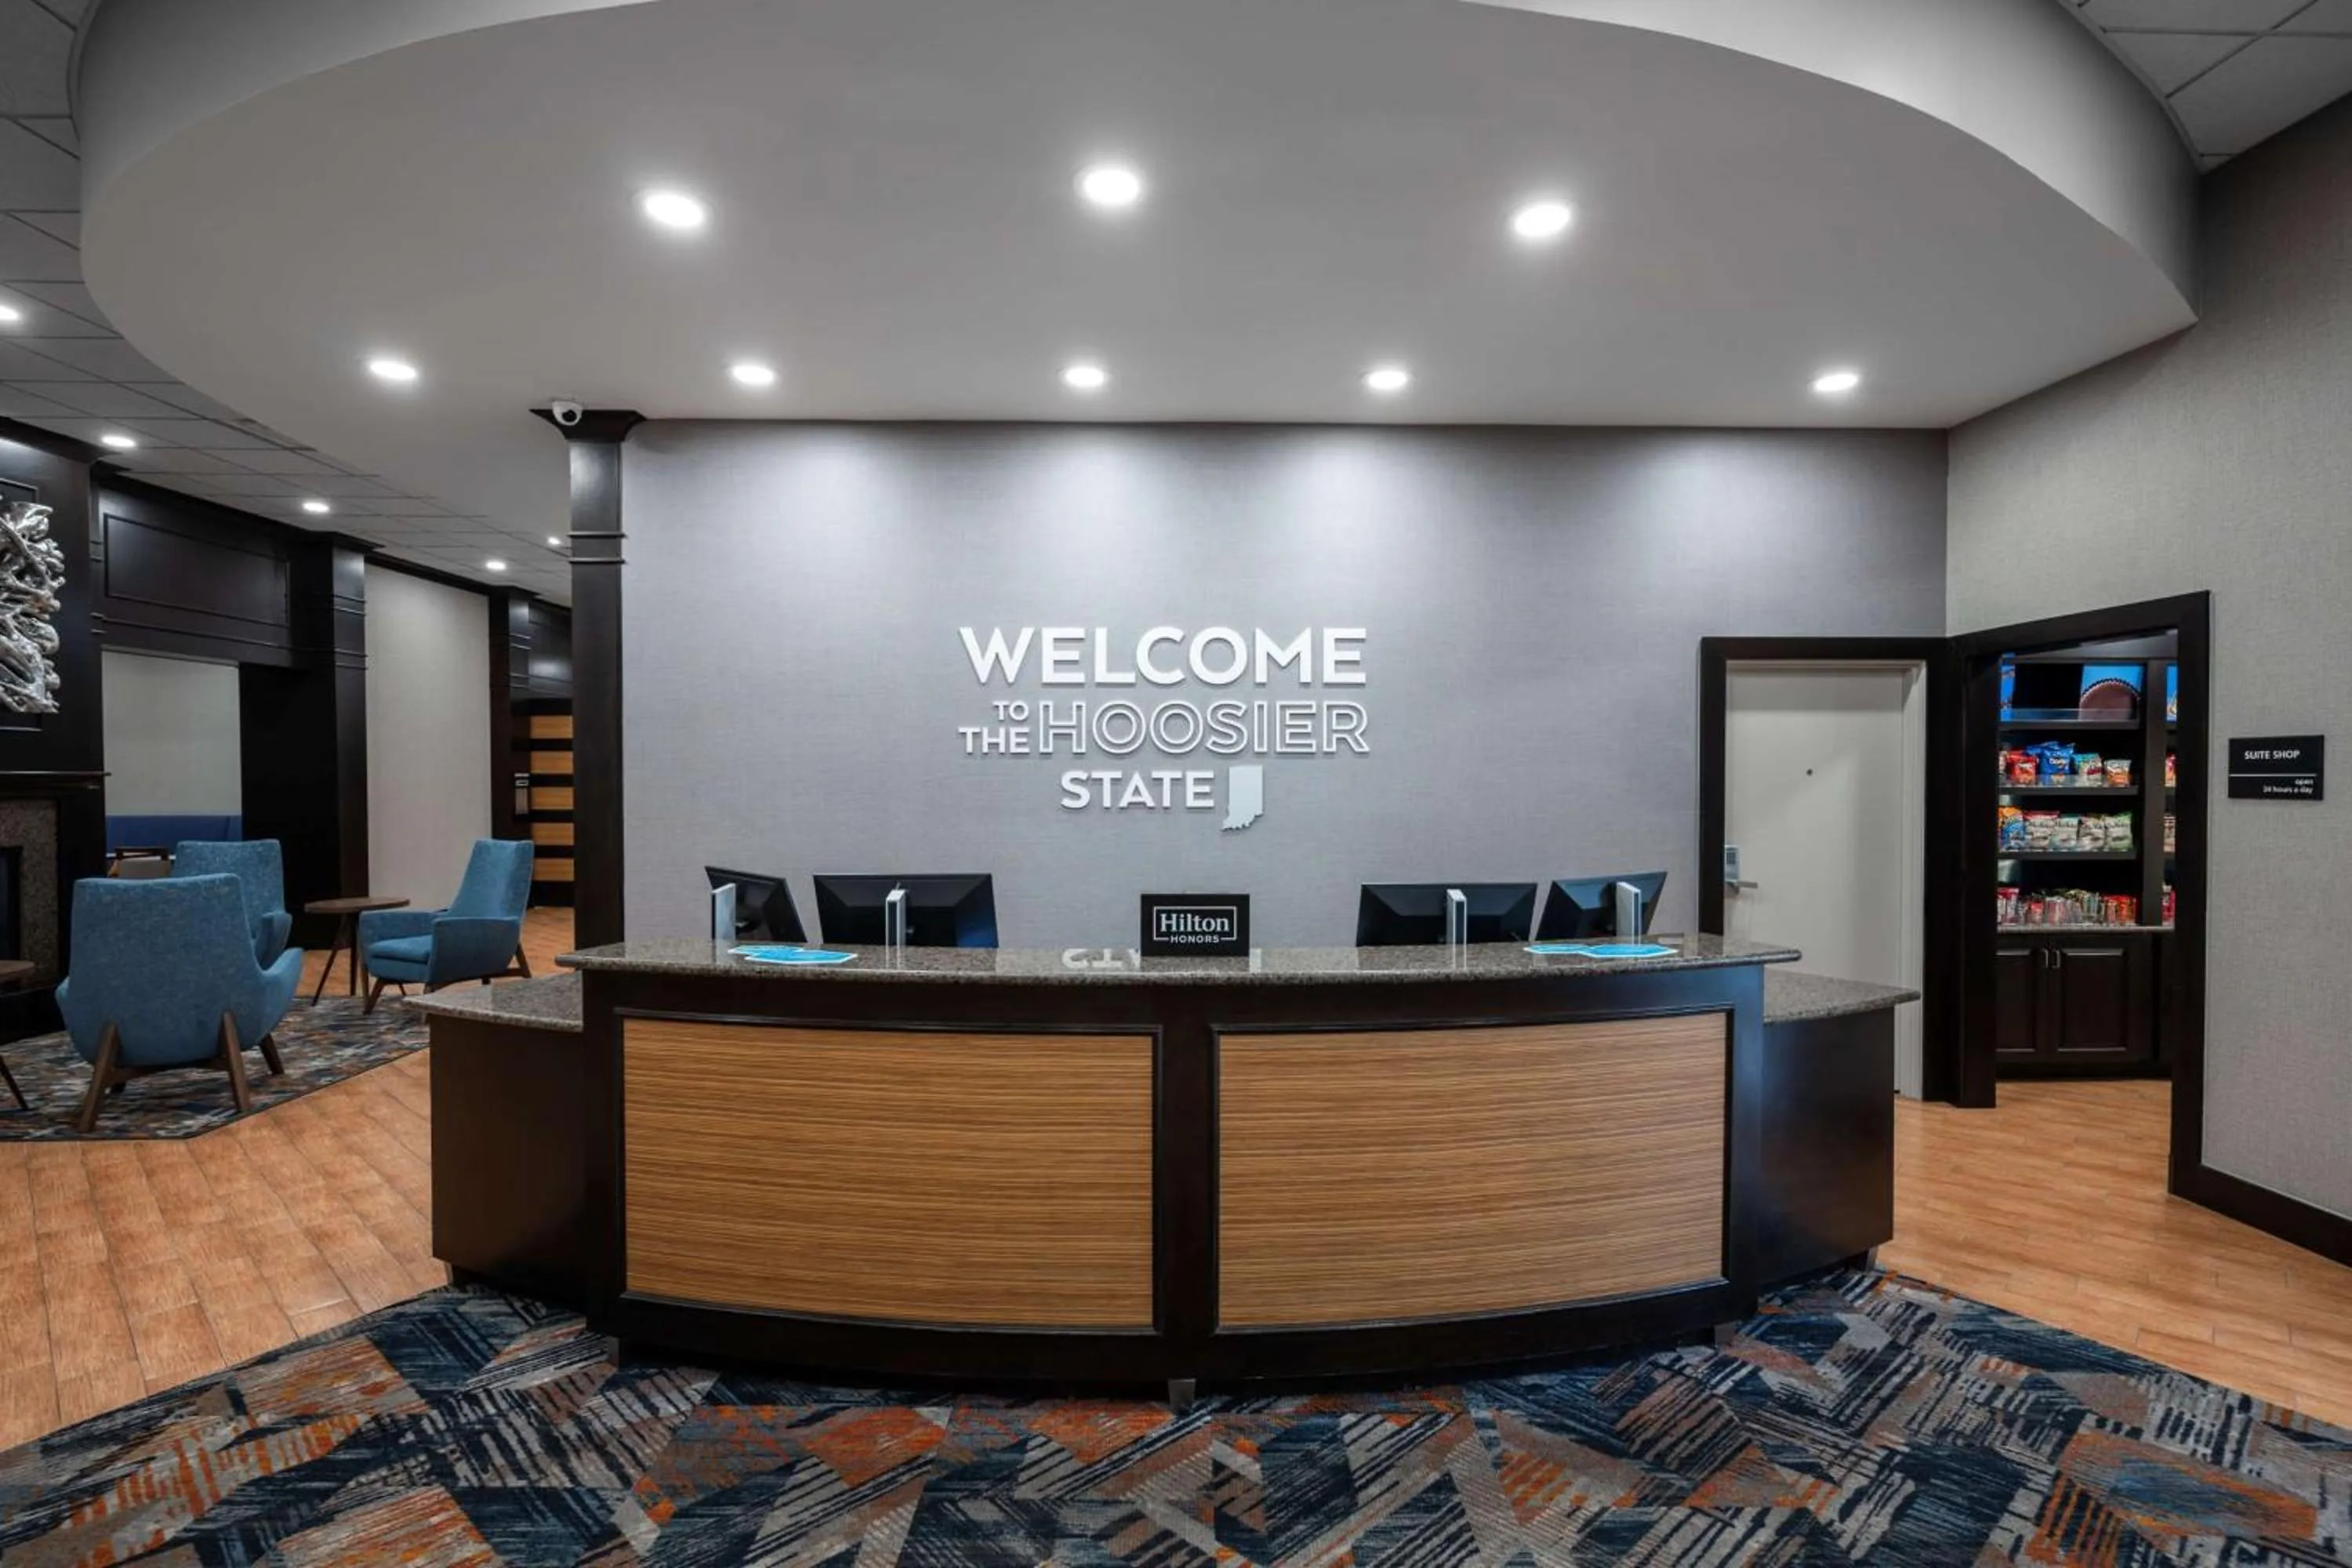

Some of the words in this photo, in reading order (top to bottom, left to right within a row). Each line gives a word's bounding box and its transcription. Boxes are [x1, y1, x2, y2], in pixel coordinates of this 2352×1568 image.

[958, 626, 1367, 685] WELCOME
[993, 701, 1029, 720] TO
[958, 726, 1030, 753] THE
[1039, 700, 1370, 753] HOOSIER
[2244, 750, 2270, 760] SUITE
[2273, 750, 2299, 759] SHOP
[1060, 770, 1214, 808] STATE
[1160, 913, 1230, 932] Hilton
